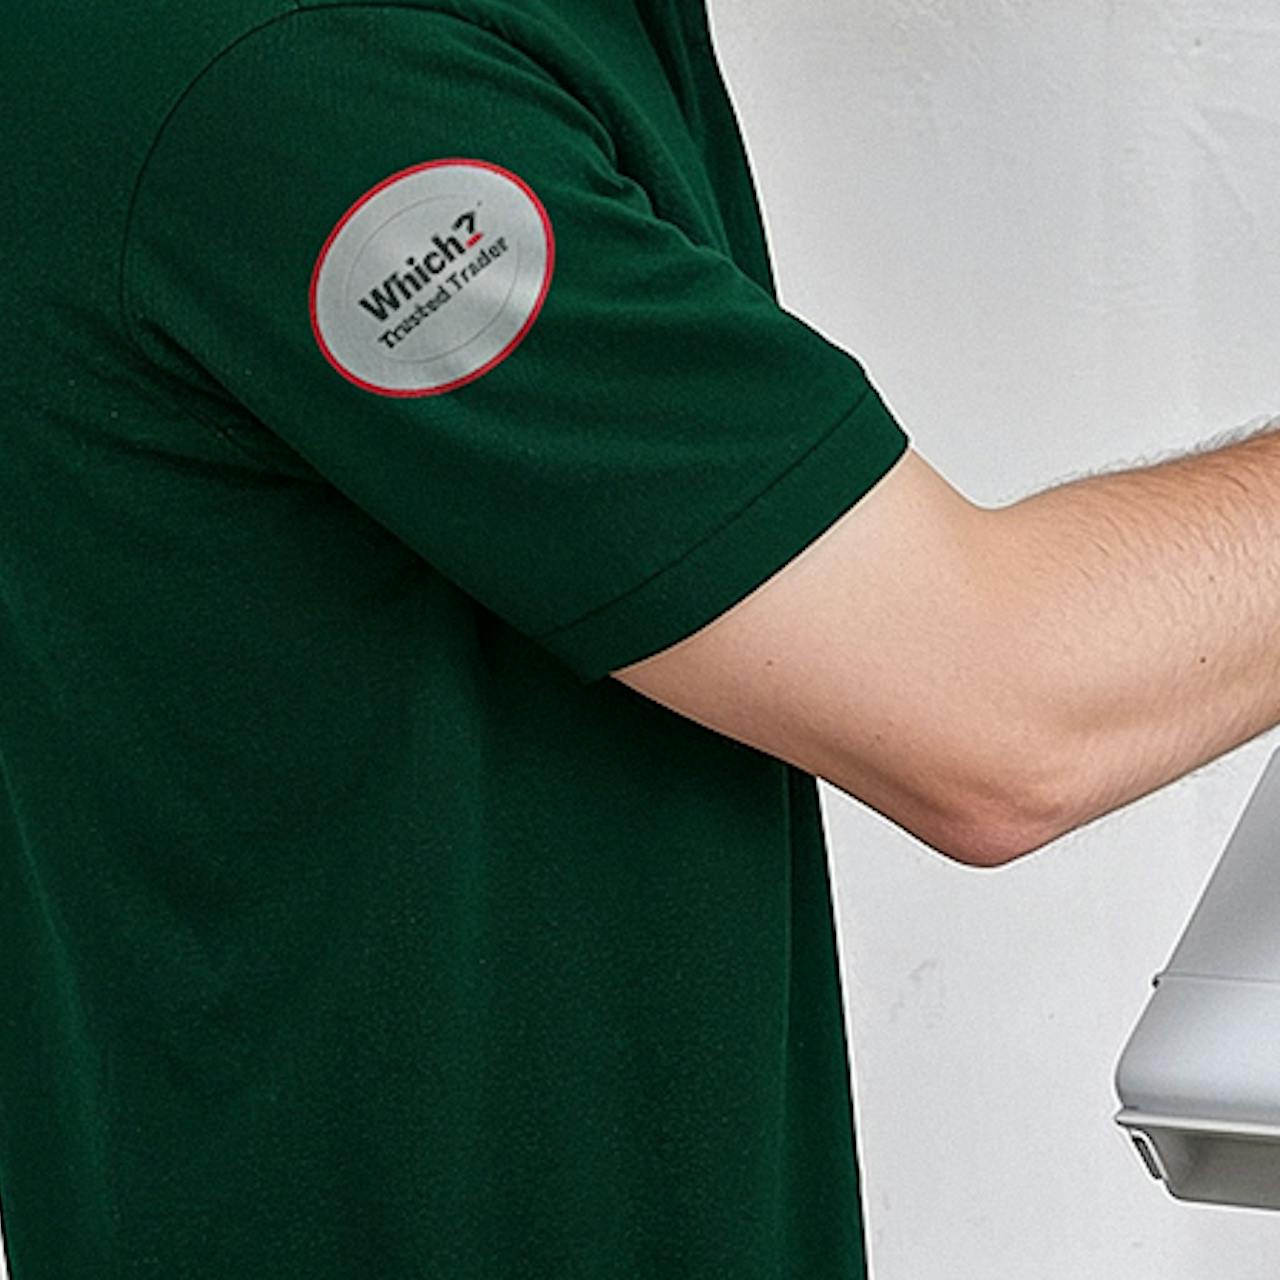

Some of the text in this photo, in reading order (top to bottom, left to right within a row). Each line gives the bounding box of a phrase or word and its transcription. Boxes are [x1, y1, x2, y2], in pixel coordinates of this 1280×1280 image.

[358, 210, 484, 322] Which?
[377, 236, 509, 349] Trusted Trader
